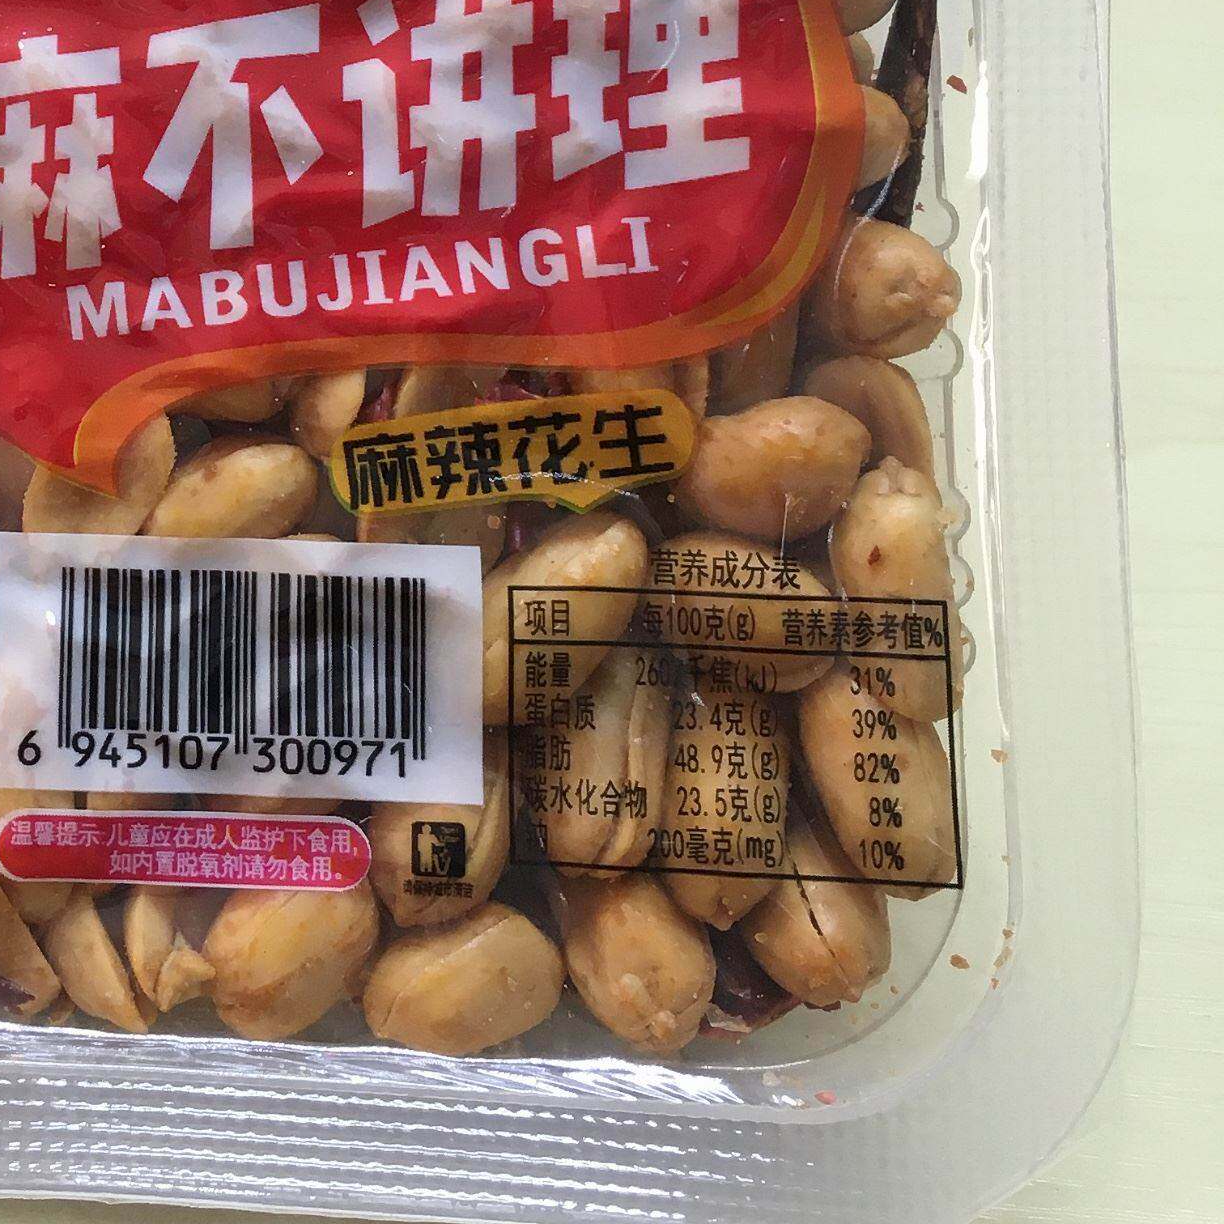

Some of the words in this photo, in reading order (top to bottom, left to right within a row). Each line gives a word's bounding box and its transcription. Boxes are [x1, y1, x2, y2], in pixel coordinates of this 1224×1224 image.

[65, 214, 662, 343] MABUJIANGLI
[342, 400, 679, 511] 麻辣花生
[650, 548, 802, 591] 营养成分表
[523, 599, 572, 637] 项目
[781, 611, 945, 653] 营养素参考值%
[524, 650, 572, 690] 能量
[849, 665, 896, 698] 31%
[524, 693, 596, 731] 蛋白质
[851, 709, 898, 742] 39%
[17, 729, 43, 768] 6
[853, 752, 901, 786] 82%
[868, 797, 904, 829] 8%
[858, 839, 906, 873] 10%
